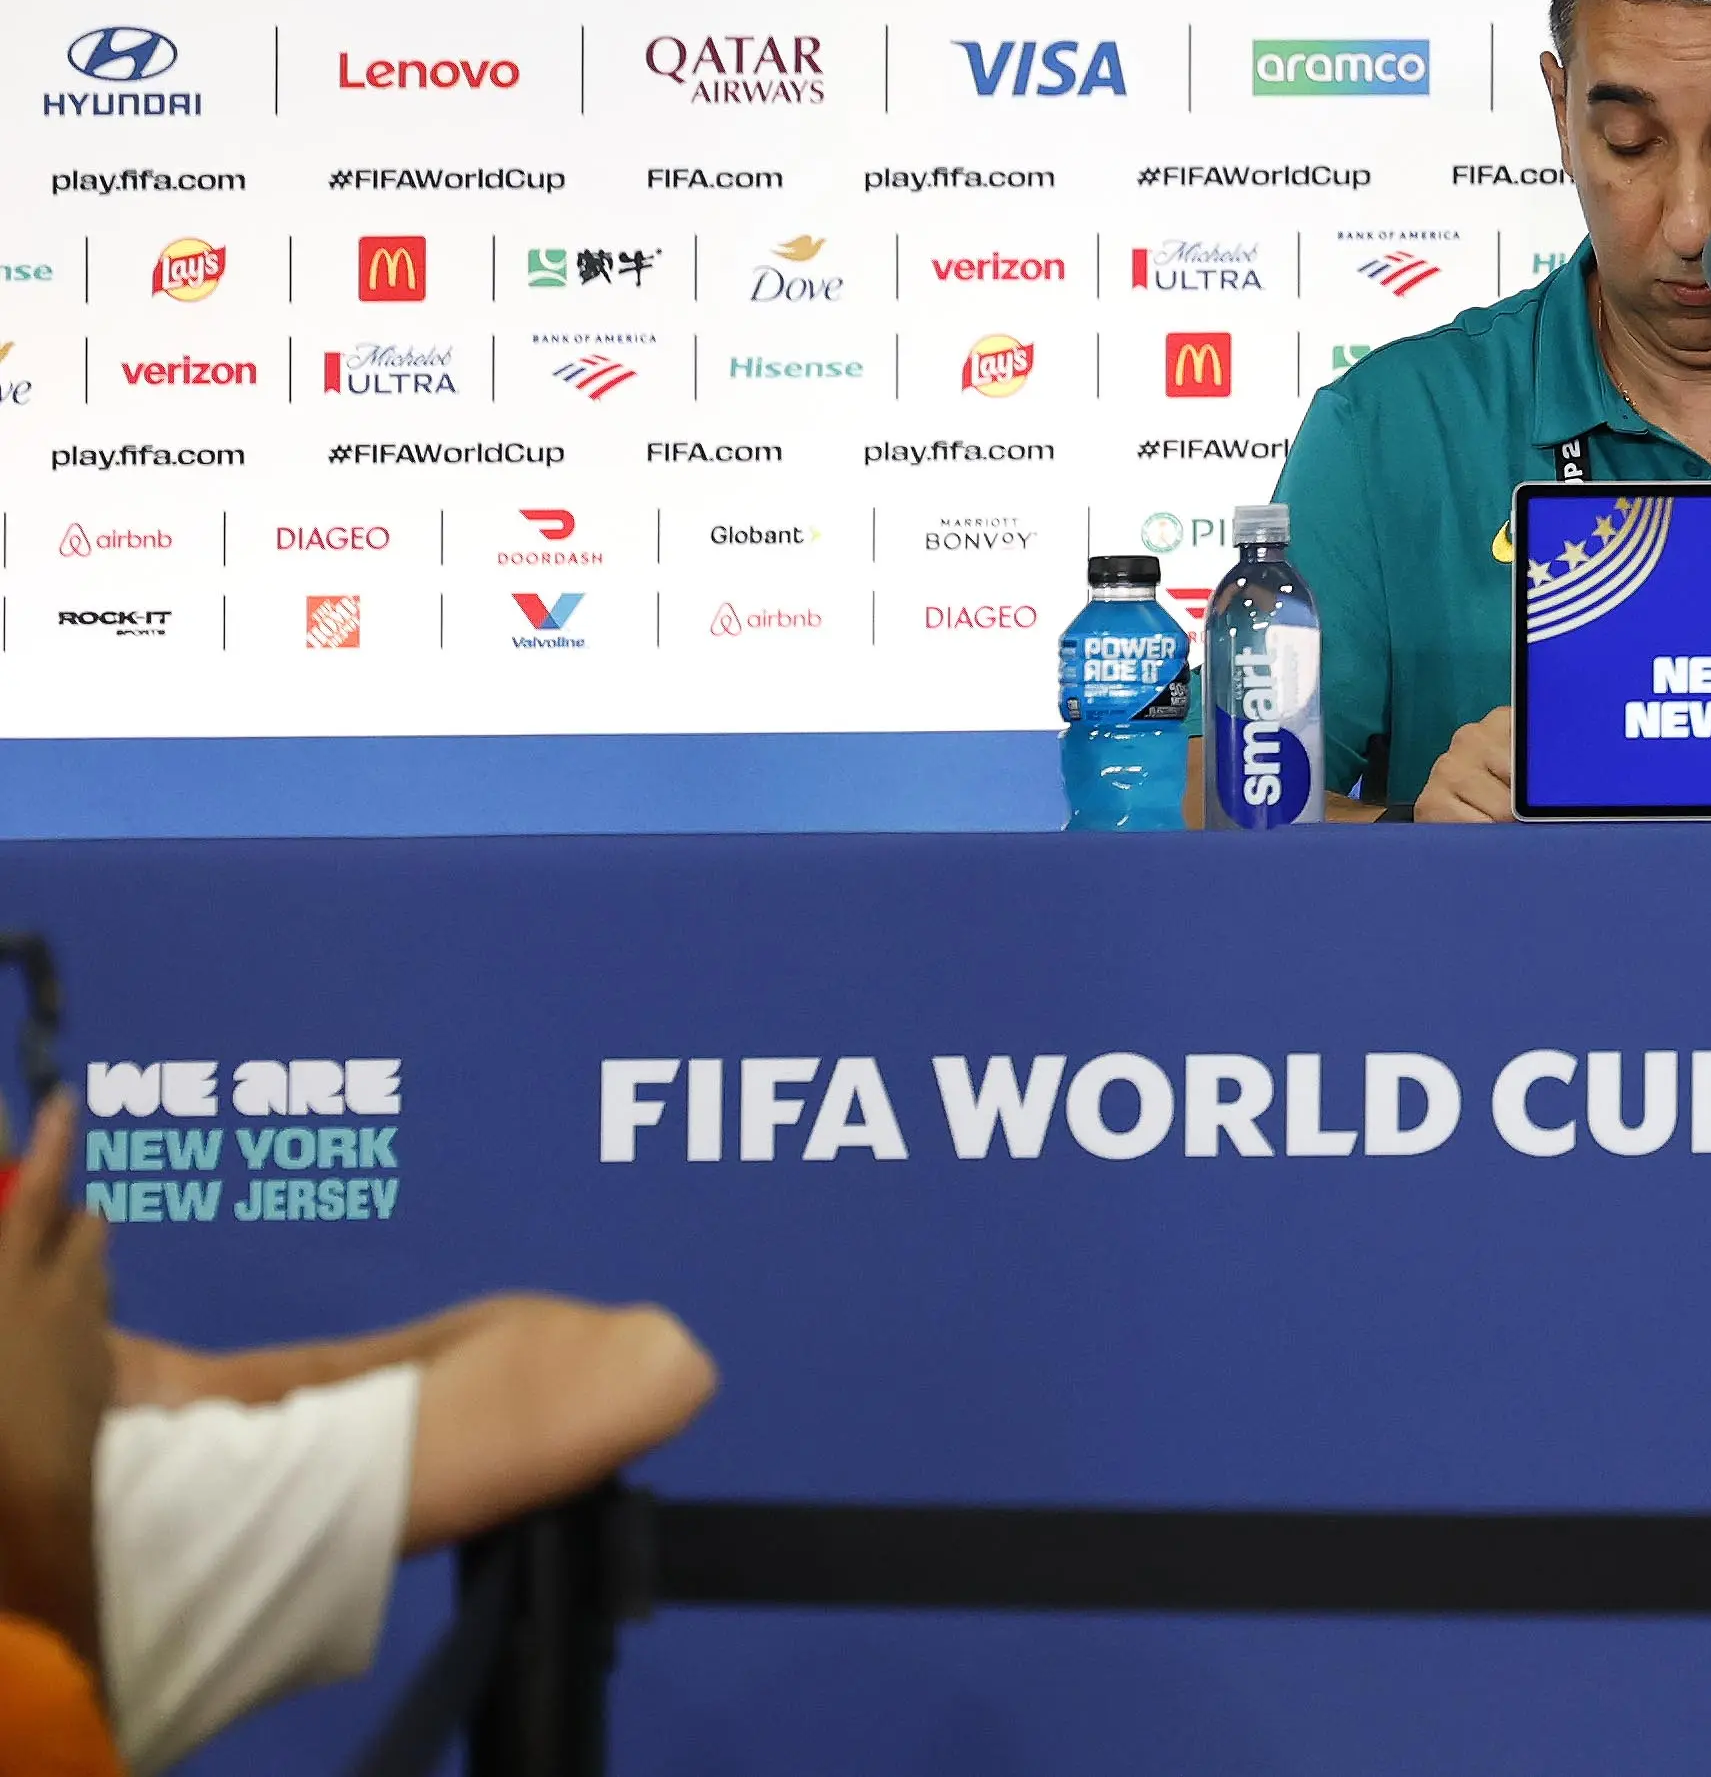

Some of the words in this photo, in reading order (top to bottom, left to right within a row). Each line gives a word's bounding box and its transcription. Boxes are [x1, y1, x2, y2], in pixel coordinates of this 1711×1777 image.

[953, 39, 1128, 97] VISA
[1257, 53, 1425, 82] aramco
[43, 92, 202, 117] HYUNDAI
[51, 168, 246, 196] play.fifa.com
[327, 167, 566, 195] #FIFAWorldCup
[647, 168, 783, 190] FIFA.com
[1136, 164, 1371, 191] #FIFAWorldCup
[160, 249, 220, 289] Lay's
[930, 251, 1065, 282] verizon
[750, 268, 844, 302] Dove
[120, 354, 257, 386] verizon
[730, 357, 863, 378] Hisense
[346, 372, 453, 395] ULTRA
[51, 444, 245, 472] play.fifa.com
[328, 442, 565, 468] #FIFAWorldCup
[96, 529, 173, 549] airbnb
[276, 526, 390, 551] DIAGEO
[710, 525, 805, 545] Globant
[925, 532, 1030, 550] BONVOY
[497, 552, 603, 565] DOORDASH
[58, 610, 173, 626] ROCK-IT
[747, 610, 822, 628] airbnb
[1083, 636, 1176, 660] POWER
[1083, 660, 1137, 682] ADE
[1235, 647, 1282, 806] smart
[87, 1061, 218, 1117] WE
[232, 1059, 402, 1116] ARE
[600, 1057, 908, 1163] FIFA
[931, 1052, 1462, 1160] WORLD
[86, 1127, 224, 1171] NEW
[235, 1127, 399, 1170] YORK
[86, 1180, 222, 1222] NEW
[234, 1178, 399, 1221] JERSEY
